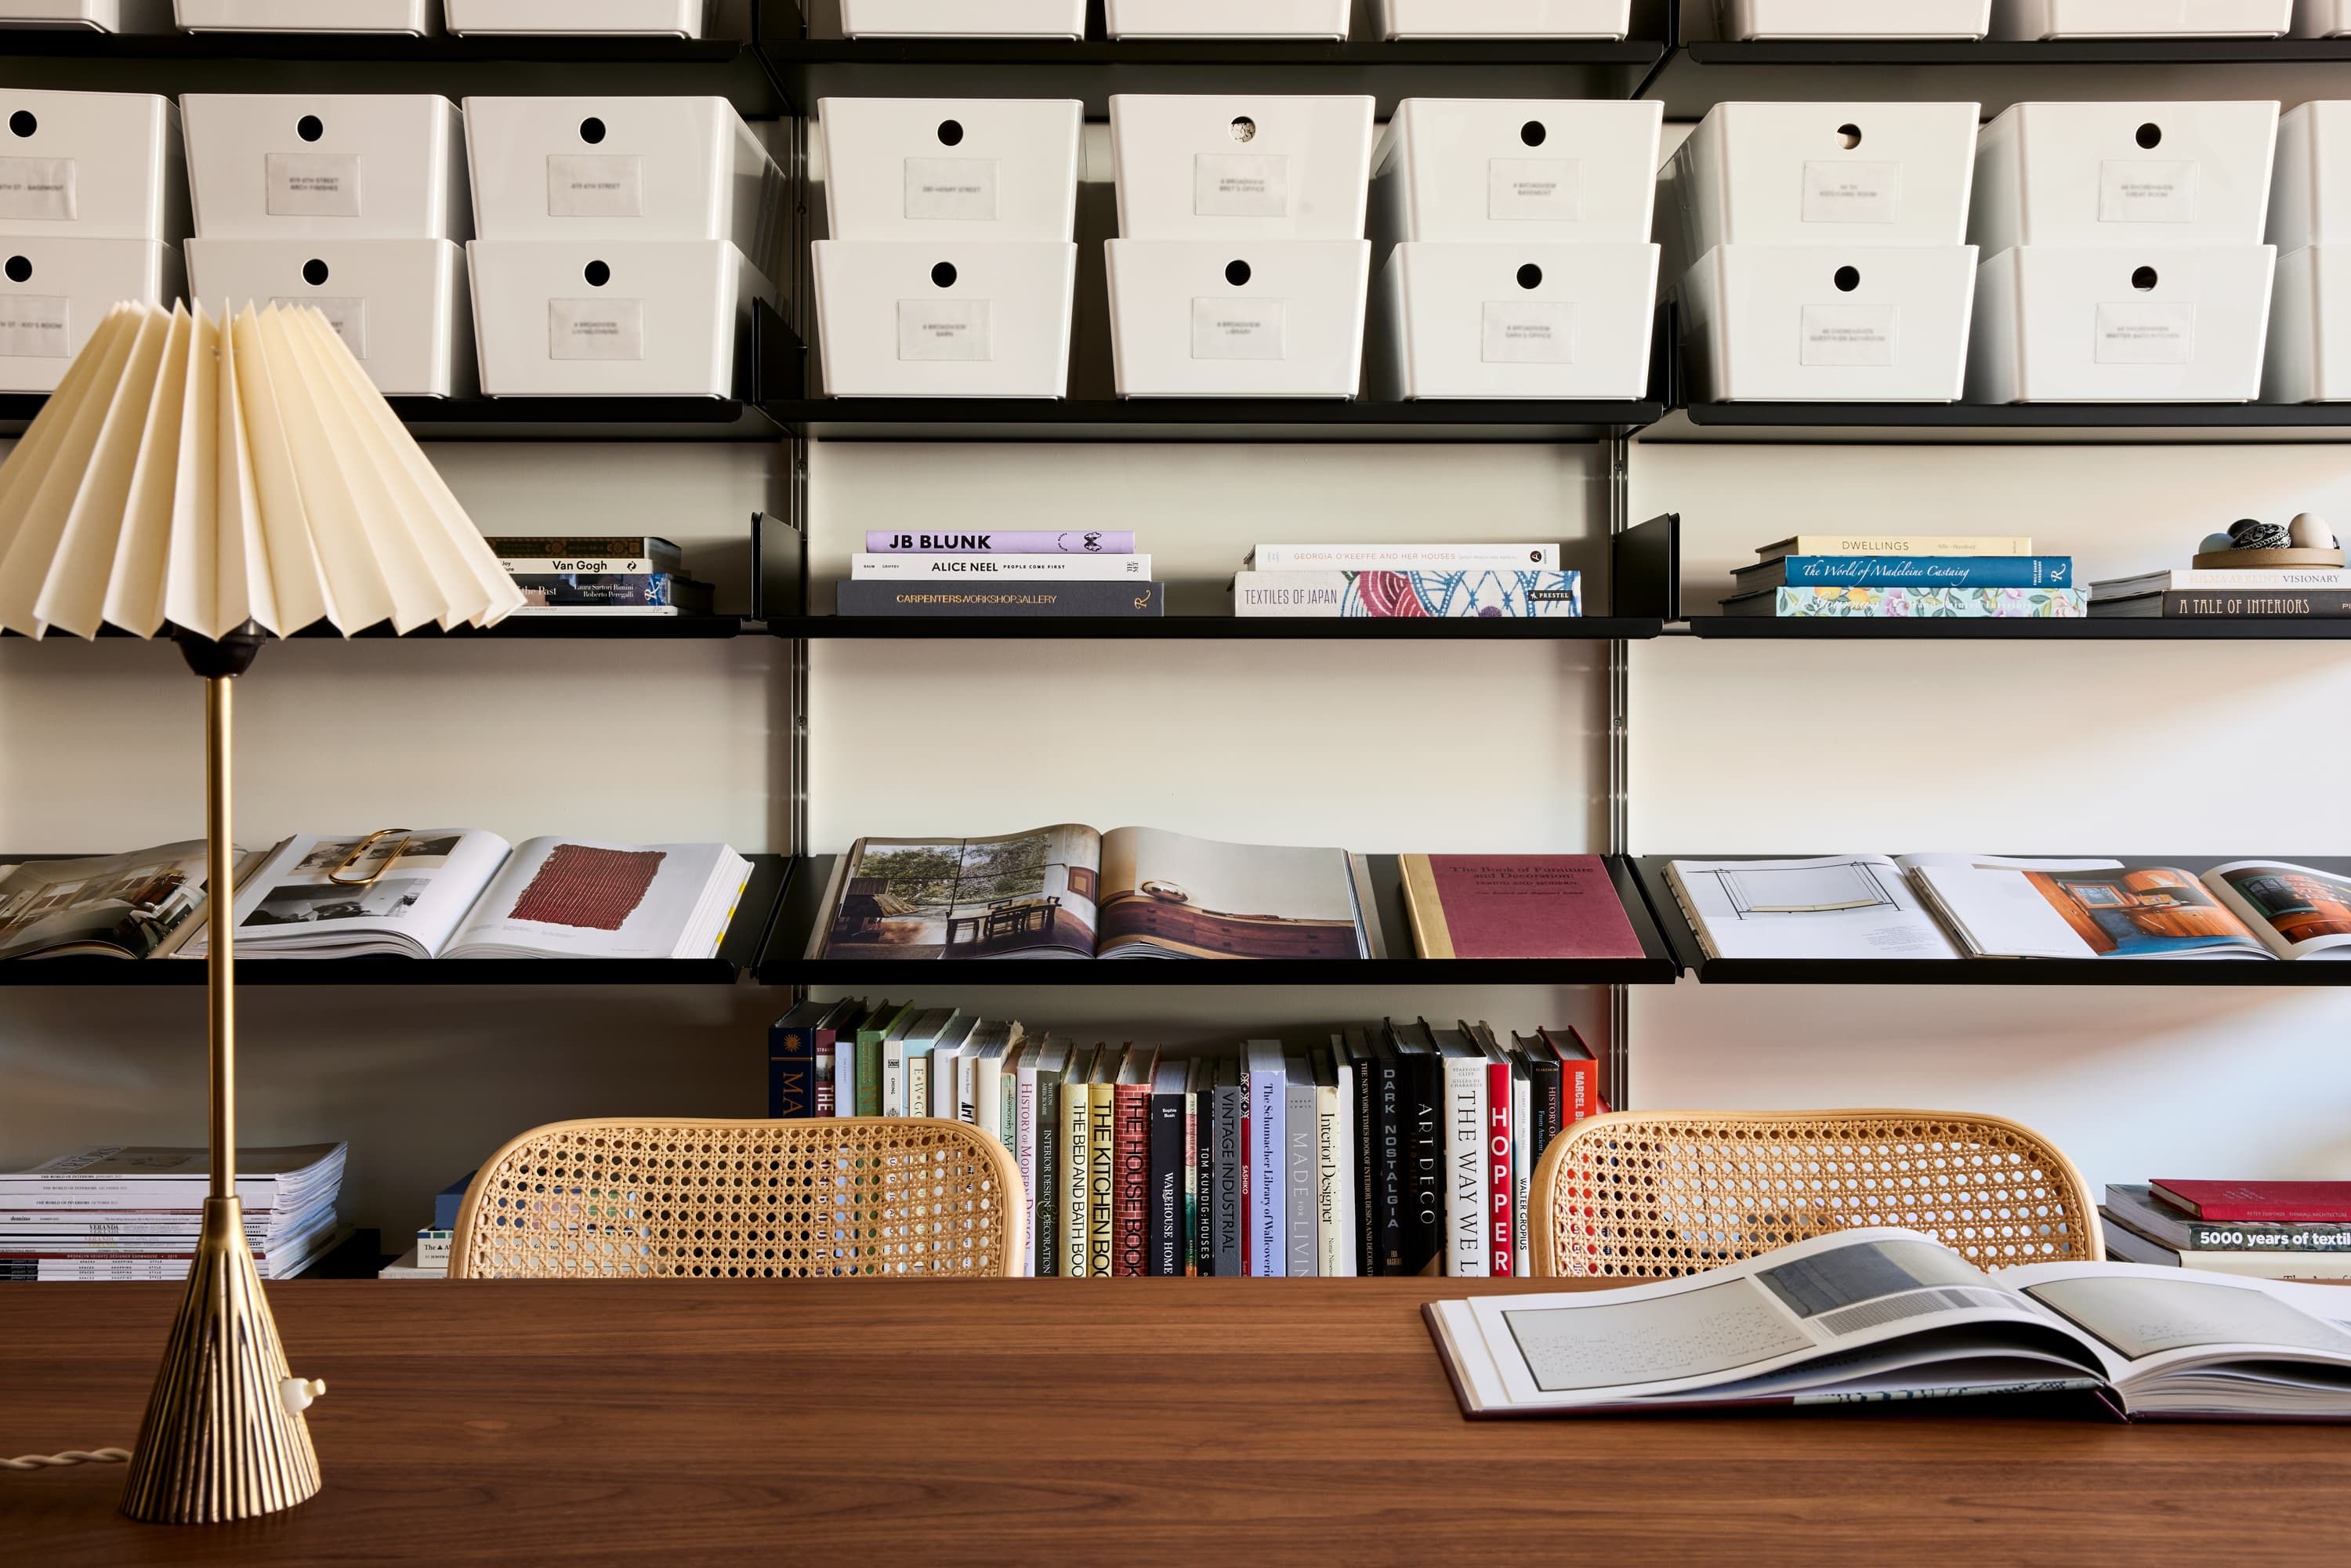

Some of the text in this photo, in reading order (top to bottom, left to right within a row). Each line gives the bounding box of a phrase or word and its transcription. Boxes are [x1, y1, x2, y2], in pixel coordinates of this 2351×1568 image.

[889, 535, 991, 549] JB BLUNK
[1842, 541, 1910, 550] DWELLINGS
[552, 561, 607, 574] Van Gogh
[931, 563, 967, 572] ALICE
[970, 563, 998, 572] NEEL
[1802, 559, 1824, 577] The
[1824, 559, 1858, 577] World
[1870, 561, 1923, 578] Madeleine
[1926, 564, 1971, 586] Castaing
[538, 586, 556, 596] Past
[1244, 589, 1337, 605] TEXTILES OF JAPAN
[2179, 599, 2188, 614] A
[2193, 599, 2223, 614] TALE
[2227, 599, 2242, 614] OF
[2247, 599, 2310, 614] INTERIORS
[782, 1072, 804, 1117] MA
[818, 1085, 835, 1111] THE
[1020, 1084, 1033, 1133] HISTORY
[1574, 1072, 1585, 1110] MARCEL
[1073, 1102, 1086, 1132] THE
[1094, 1100, 1111, 1142] THE
[1549, 1127, 1556, 1136] OF
[1022, 1135, 1028, 1146] OF
[1072, 1135, 1086, 1166] BED
[1260, 1083, 1273, 1219] The Schumacher Library of
[1384, 1069, 1400, 1229] DARK NOSTALGIA
[1223, 1092, 1234, 1253] VINTAGE INDUSTRIAL
[1293, 1133, 1309, 1197] MADE
[1319, 1113, 1336, 1226] Interior Designer
[1364, 1157, 1371, 1166] OF
[1418, 1103, 1436, 1224] ART DECO
[1458, 1091, 1478, 1251] THE WAY WE
[1042, 1130, 1052, 1274] INTERIOR DESIGN DECORATION
[1072, 1168, 1086, 1199] AND
[1092, 1147, 1111, 1234] KITCHEN
[1124, 1092, 1144, 1276] THE HOUSE BOOK
[1491, 1106, 1509, 1271] HOPPER
[1072, 1202, 1085, 1239] BATH
[1201, 1147, 1209, 1260] TOM KUNDIG:HOUSES
[1163, 1172, 1174, 1275] WAREHOUSE HOME
[2200, 1232, 2243, 1244] 5000
[2246, 1233, 2289, 1247] years
[2291, 1232, 2309, 1245] of
